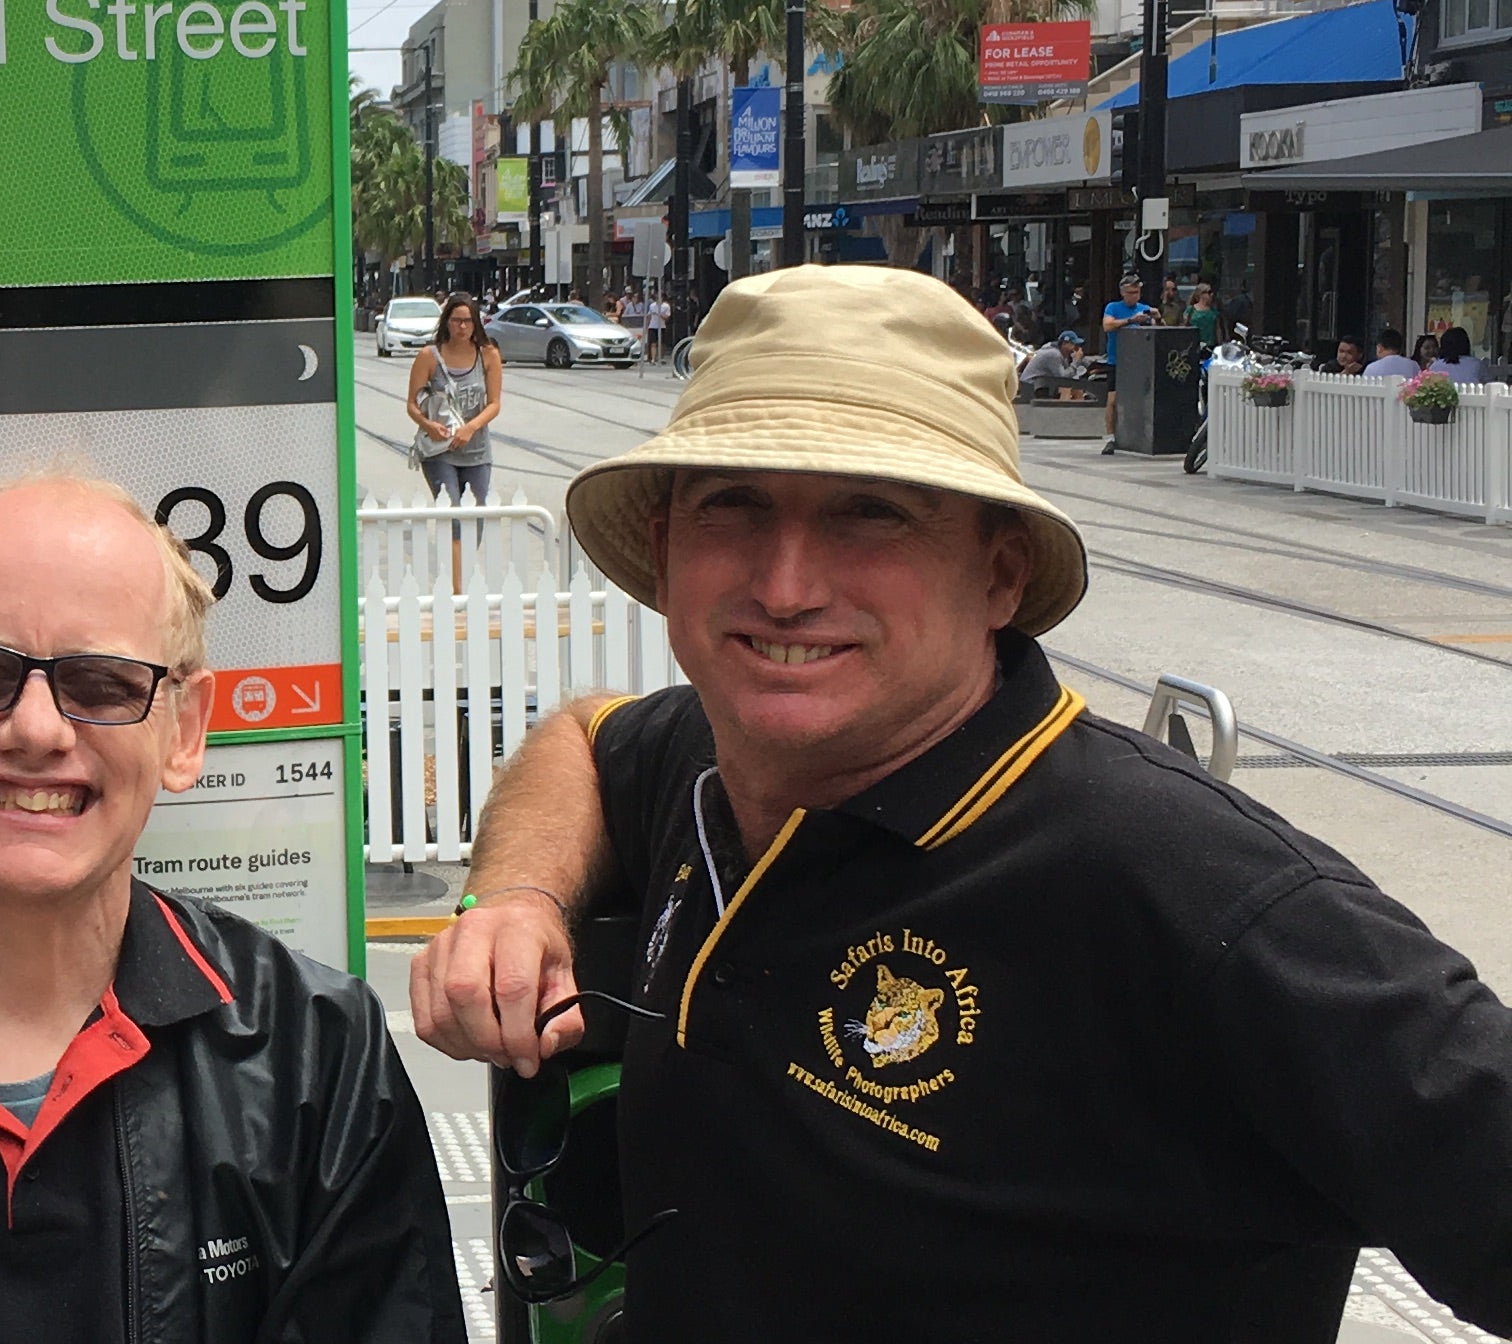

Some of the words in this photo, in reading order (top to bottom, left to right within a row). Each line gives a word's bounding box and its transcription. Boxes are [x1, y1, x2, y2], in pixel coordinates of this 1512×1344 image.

[985, 48, 1010, 59] FOR
[1014, 46, 1054, 58] LEASE
[1031, 58, 1078, 66] OPPORTUNITY
[742, 106, 752, 117] A
[739, 117, 777, 131] MILLION
[733, 127, 777, 143] BRILLIANT
[733, 143, 777, 157] FLAVOURS
[803, 213, 833, 229] ANZ
[231, 773, 246, 787] ID
[276, 761, 333, 784] 1544
[133, 857, 183, 875] Tram
[189, 854, 242, 872] route
[248, 848, 311, 872] guides
[170, 885, 213, 895] Melbourne
[215, 885, 234, 893] with
[247, 882, 274, 892] guides
[275, 878, 308, 889] covering
[202, 892, 251, 903] Melbourne's
[252, 892, 271, 900] tram
[830, 931, 895, 990] Safaris
[902, 928, 946, 965] Into
[945, 967, 982, 1045] Africa
[818, 1007, 844, 1068] Wildlife
[845, 1065, 955, 1104] Photographers
[208, 1237, 249, 1258] Motors
[204, 1255, 260, 1284] TOYOTA
